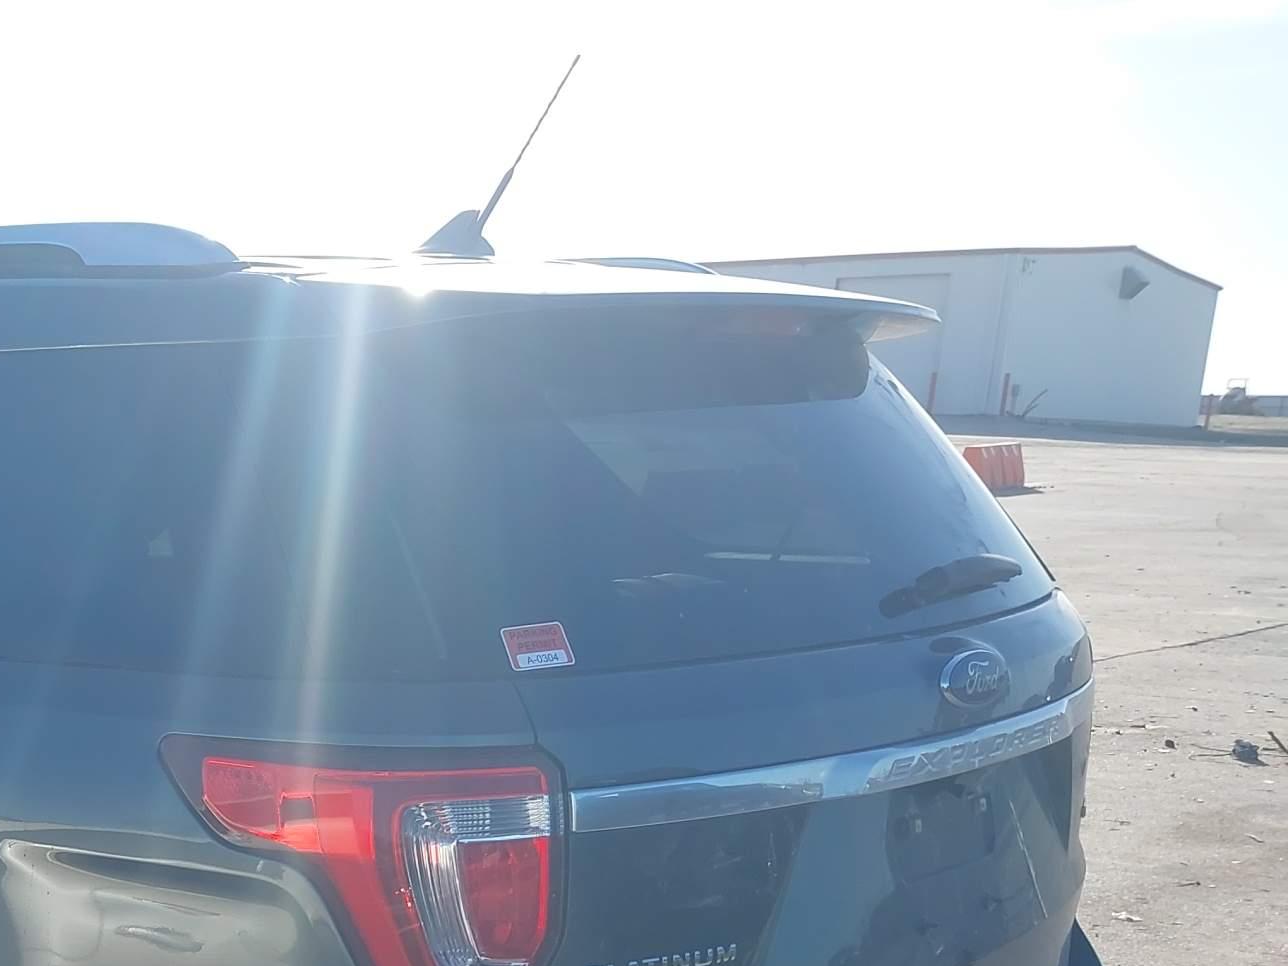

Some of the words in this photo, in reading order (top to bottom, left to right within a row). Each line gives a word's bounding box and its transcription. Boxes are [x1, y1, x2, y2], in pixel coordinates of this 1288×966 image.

[527, 652, 559, 665] A-0304
[965, 661, 1000, 695] Ford
[887, 717, 1061, 778] EXPLORER
